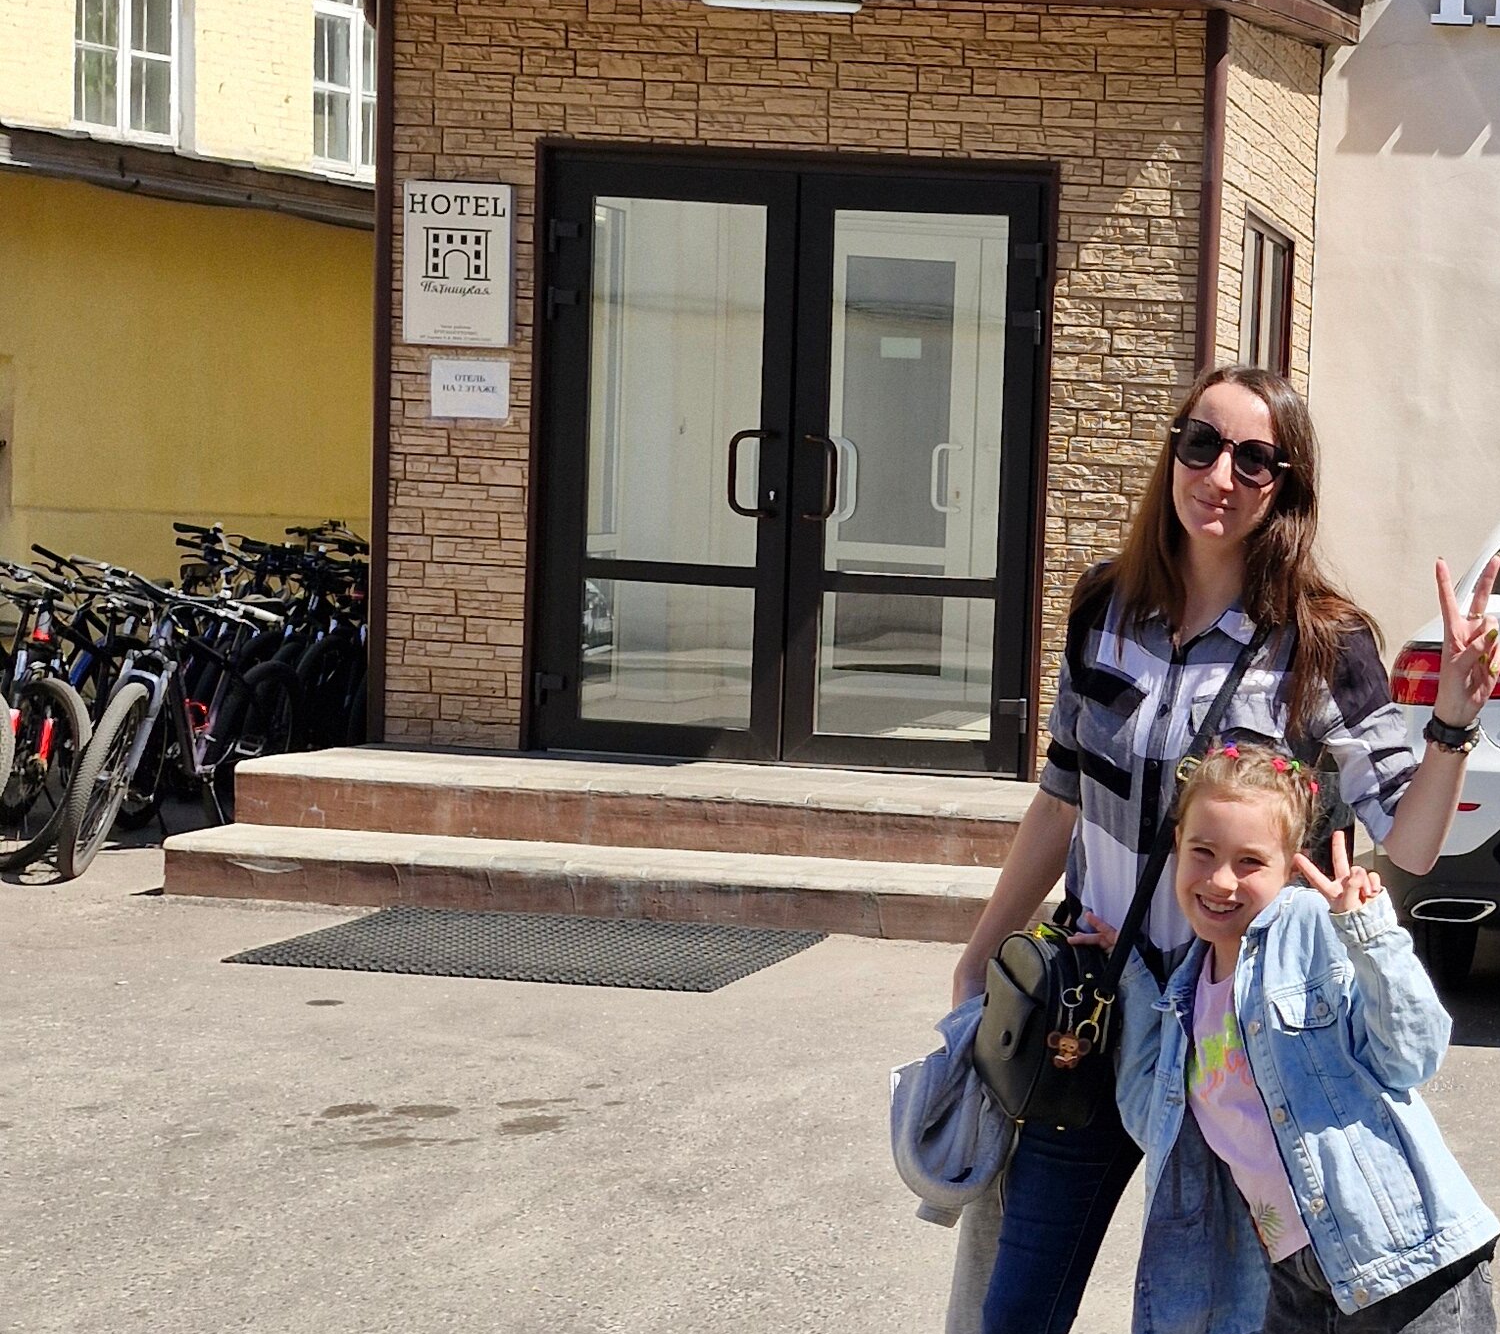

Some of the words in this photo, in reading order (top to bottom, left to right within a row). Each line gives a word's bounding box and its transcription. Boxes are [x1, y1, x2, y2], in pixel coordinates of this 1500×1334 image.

[408, 192, 506, 218] HOTEL
[420, 280, 491, 297] Пятницкая
[454, 374, 486, 383] ОТЕЛЬ
